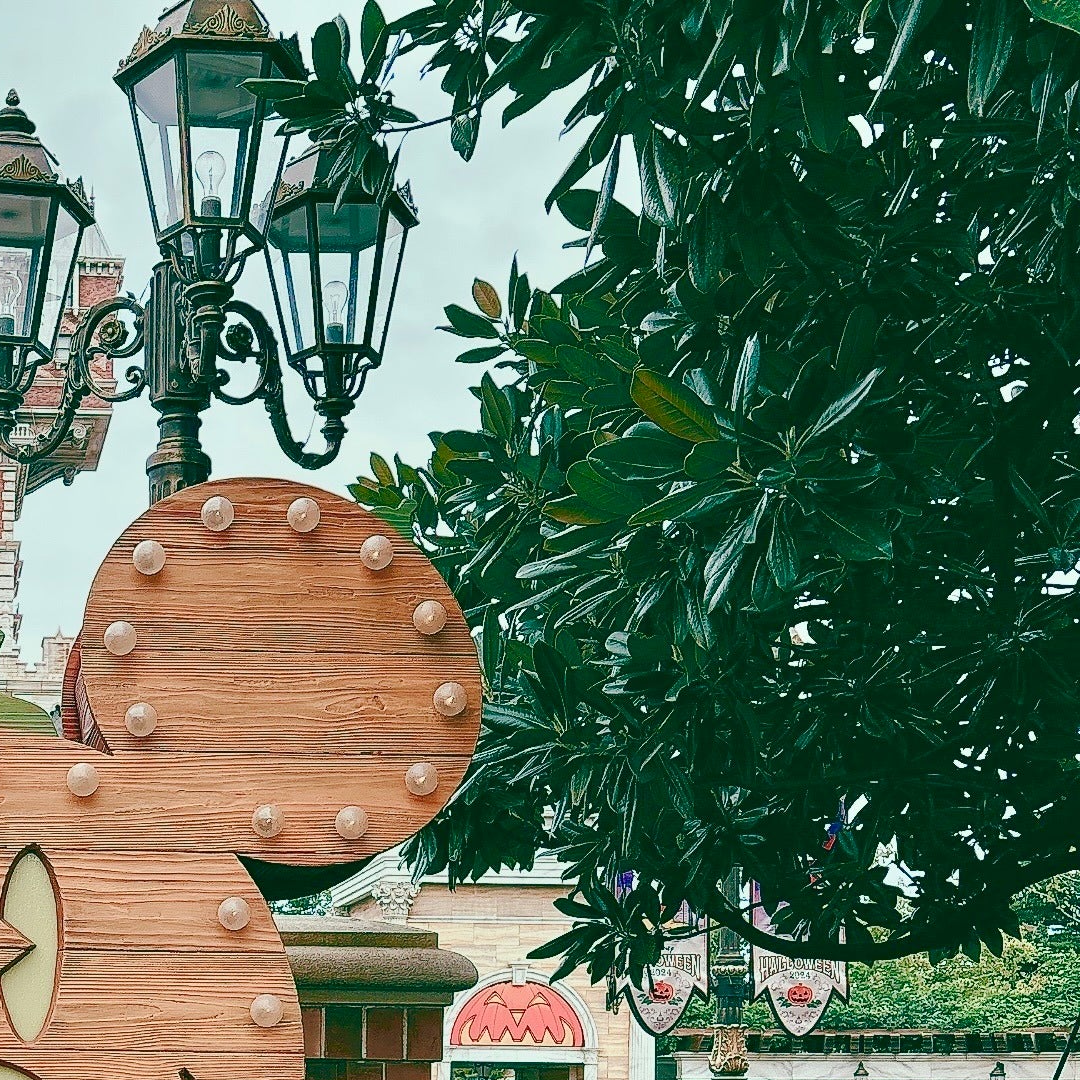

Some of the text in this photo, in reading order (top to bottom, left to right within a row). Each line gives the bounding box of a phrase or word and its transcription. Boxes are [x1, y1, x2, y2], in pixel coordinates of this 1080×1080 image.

[651, 968, 672, 977] 2024
[656, 953, 702, 981] OWEEN
[758, 955, 841, 984] HALLOWEEN
[789, 971, 811, 979] 2024
